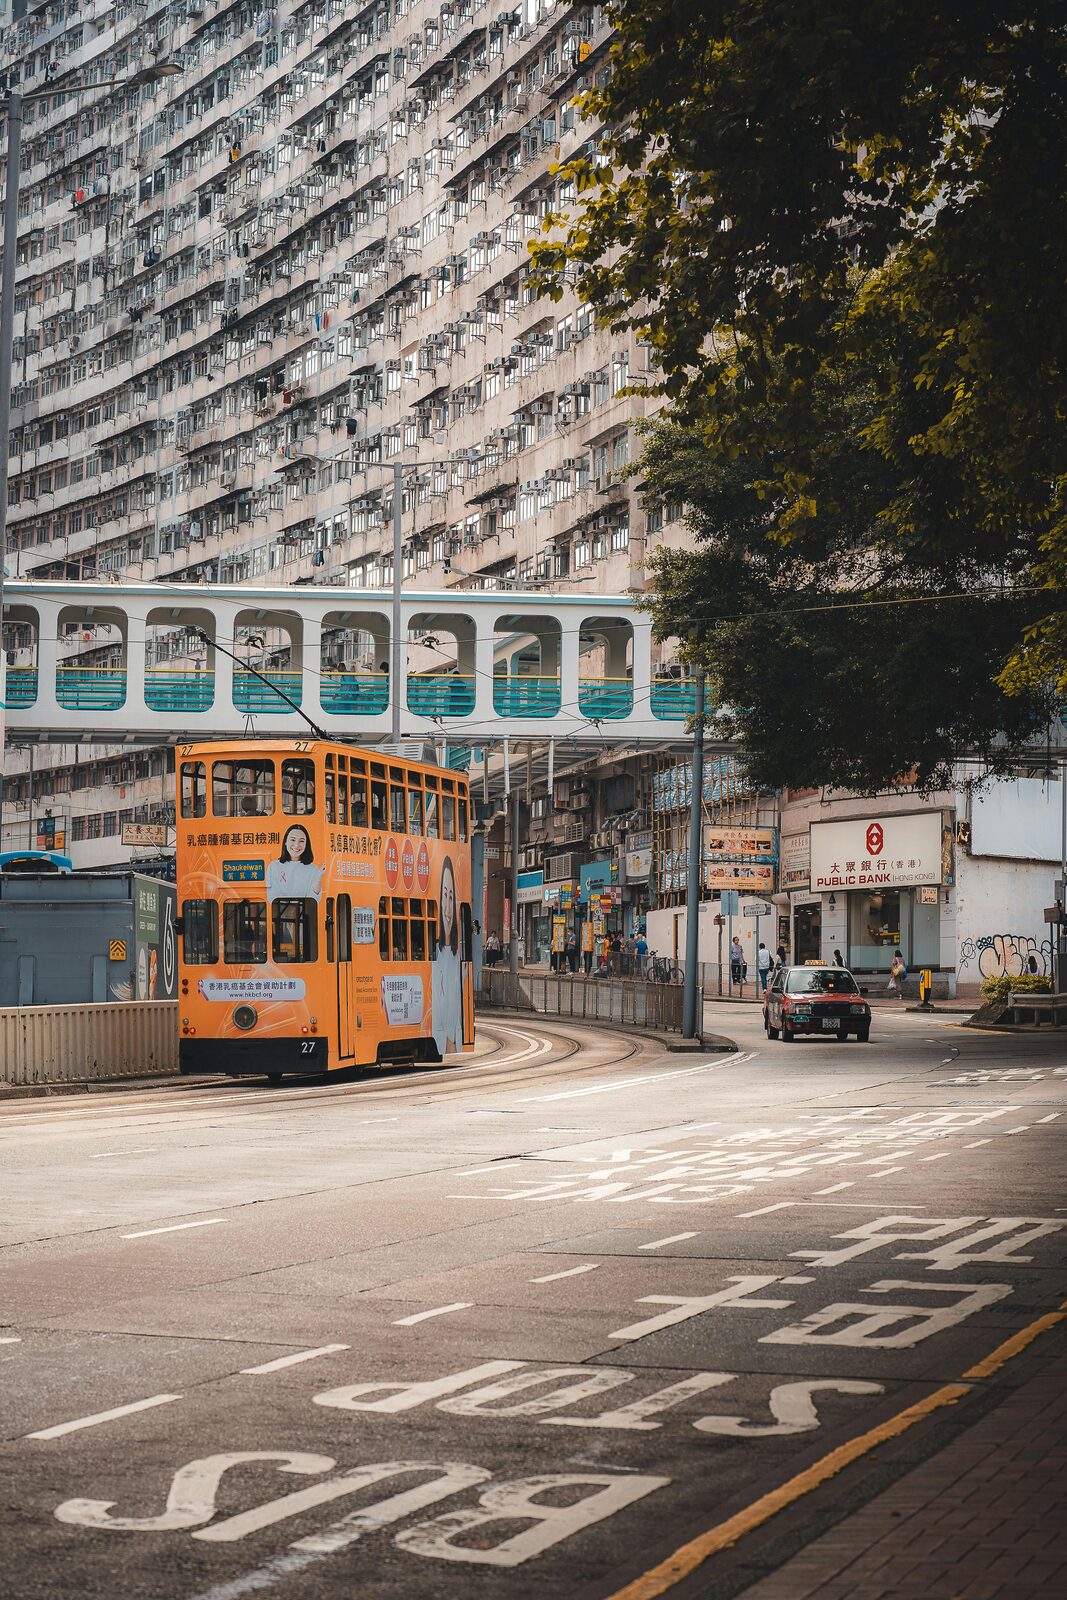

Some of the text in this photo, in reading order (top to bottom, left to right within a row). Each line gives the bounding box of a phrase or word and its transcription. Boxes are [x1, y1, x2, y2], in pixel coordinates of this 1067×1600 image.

[181, 745, 194, 757] 27
[294, 741, 309, 752] 27
[187, 832, 280, 847] 乳癌腫瘤基因檢測
[223, 863, 263, 872] Shaukeiwan
[816, 875, 856, 887] PUBLIC
[858, 873, 891, 884] BANK
[208, 981, 296, 991] 香港乳癌基金會資助計劃
[301, 1041, 316, 1054] 27
[579, 1149, 795, 1166] BUS
[550, 1165, 812, 1182] WAY
[445, 1181, 756, 1203] GIVE
[608, 1275, 1015, 1349] 巴士
[312, 1360, 884, 1436] STOP
[54, 1450, 672, 1567] BUS
